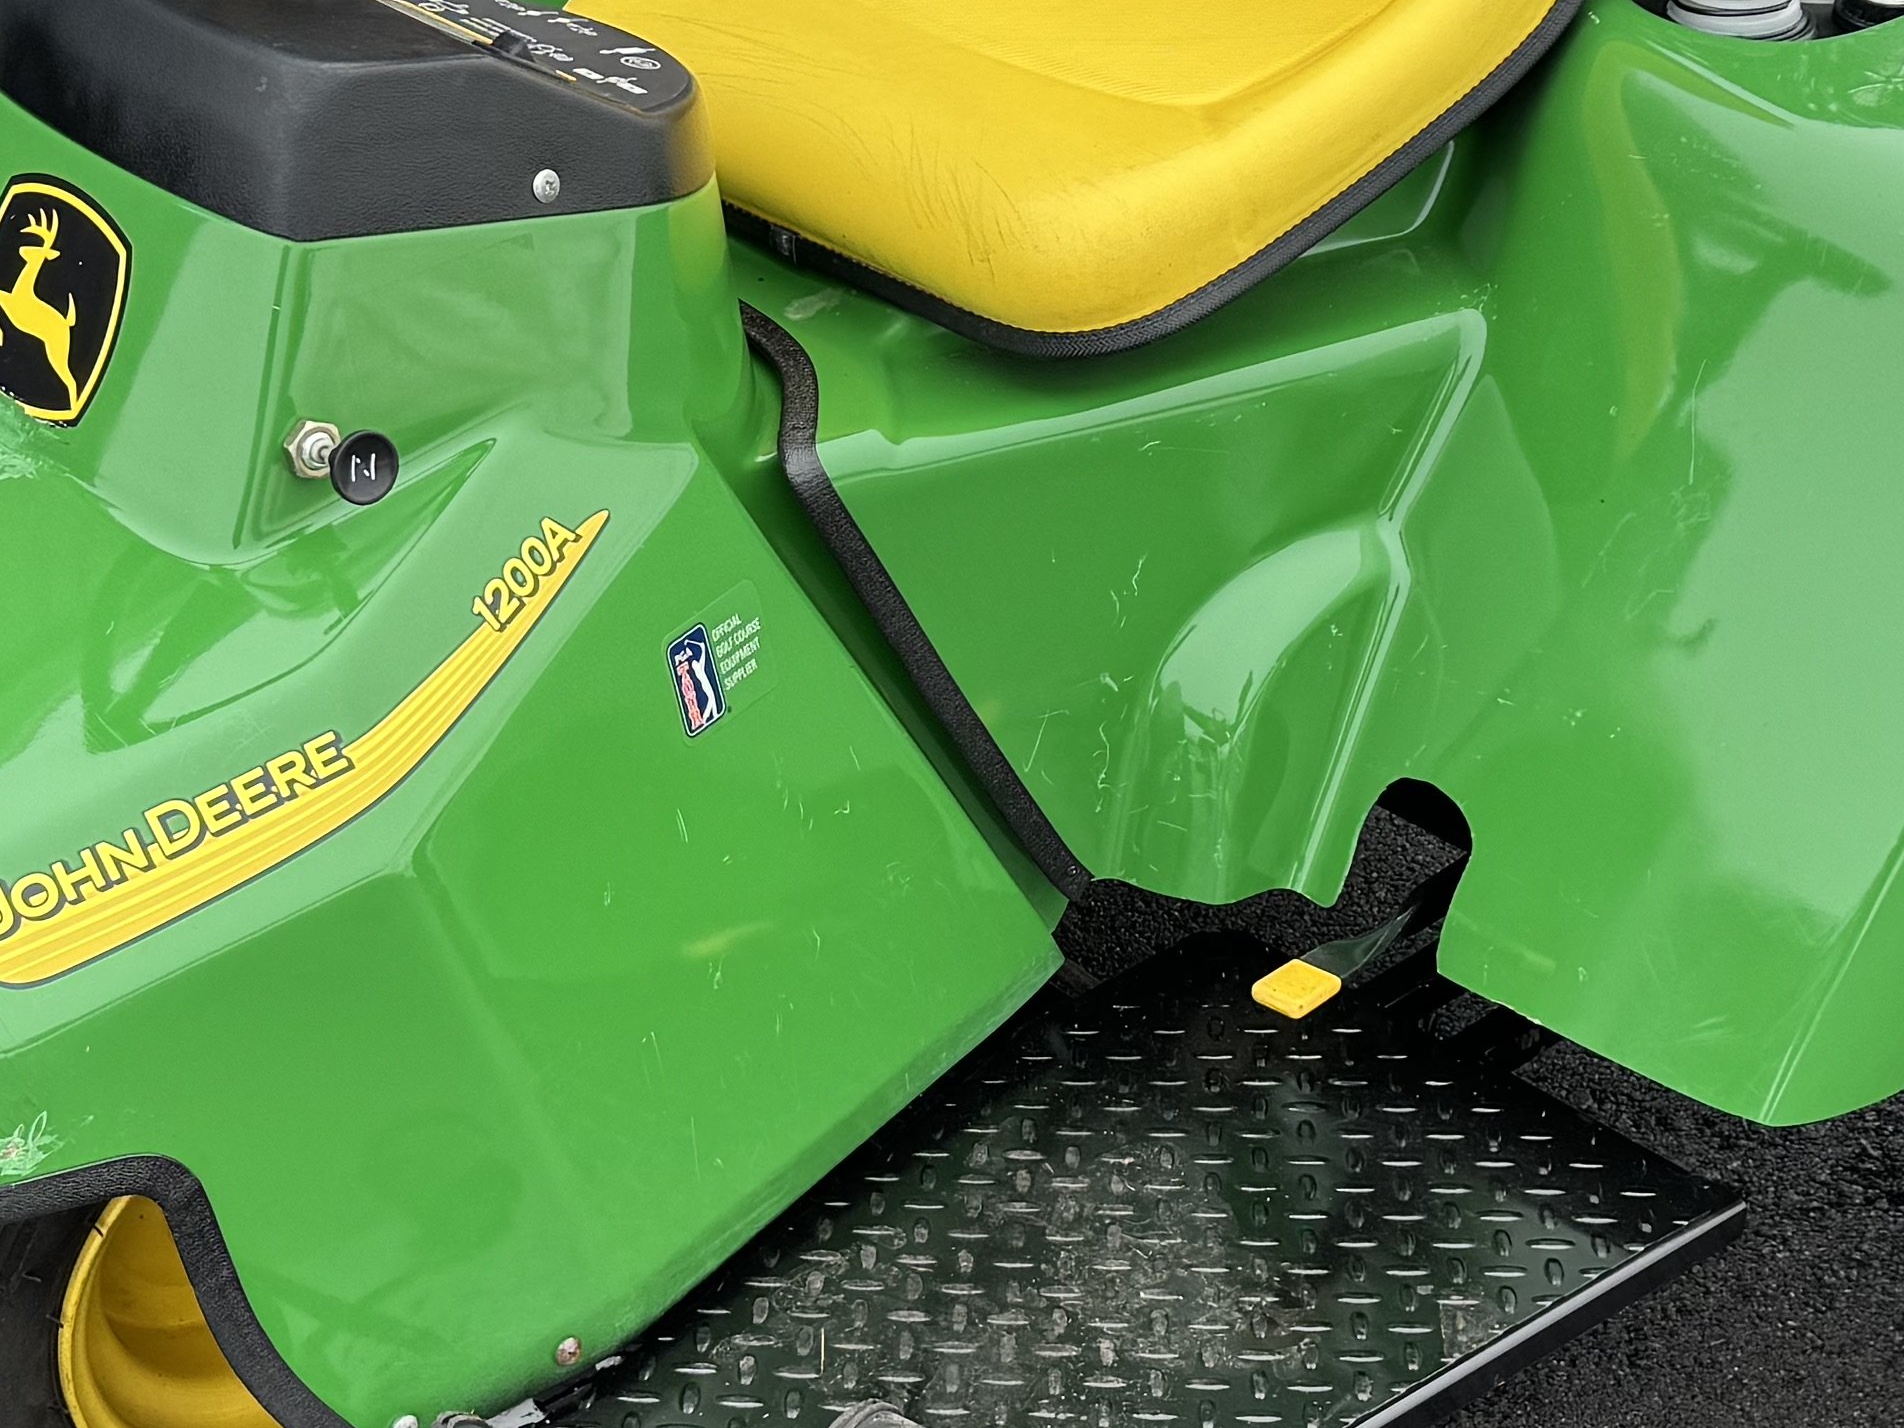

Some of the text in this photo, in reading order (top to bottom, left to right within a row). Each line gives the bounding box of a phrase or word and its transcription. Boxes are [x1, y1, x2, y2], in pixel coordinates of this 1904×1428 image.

[472, 516, 583, 632] 1200A
[720, 636, 761, 674] EQUIPMENT
[144, 730, 355, 859] DEERE
